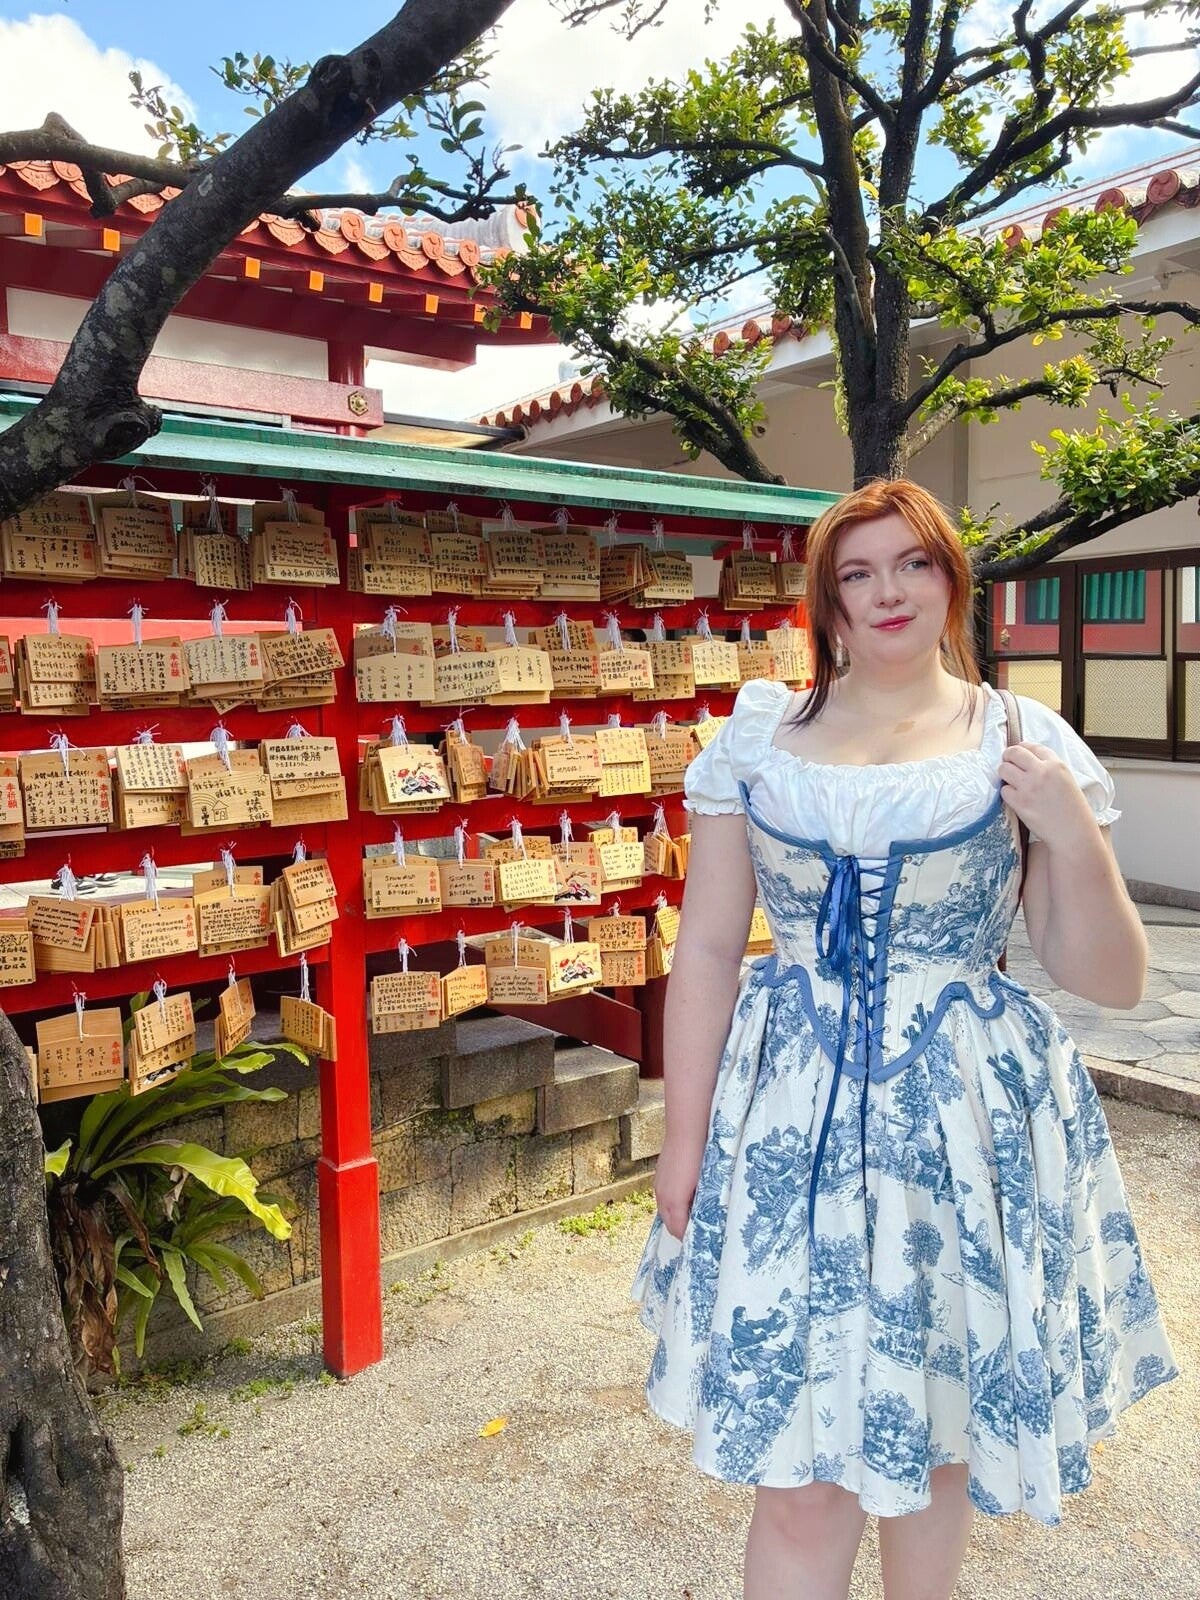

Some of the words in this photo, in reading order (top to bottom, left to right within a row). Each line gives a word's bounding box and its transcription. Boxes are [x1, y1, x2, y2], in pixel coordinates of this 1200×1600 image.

[5, 783, 16, 809] 奉祈願
[100, 783, 110, 809] 奉祈願
